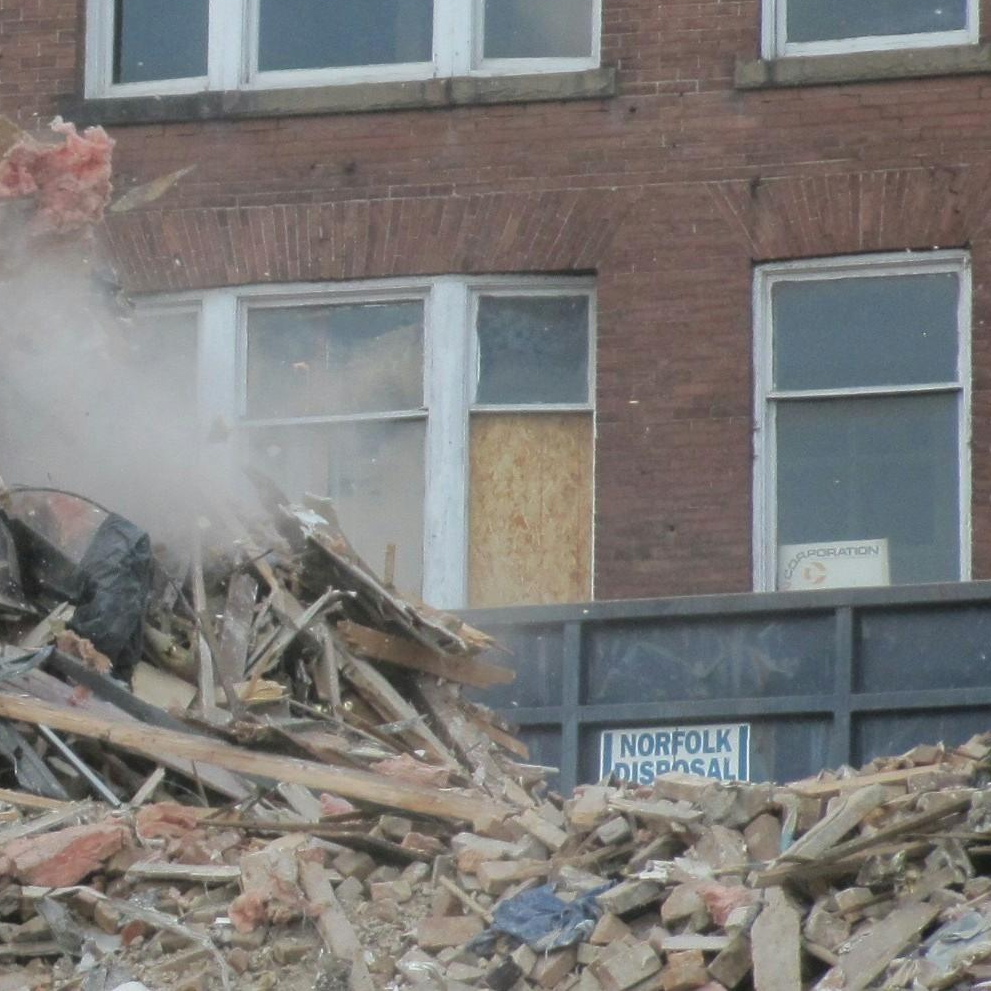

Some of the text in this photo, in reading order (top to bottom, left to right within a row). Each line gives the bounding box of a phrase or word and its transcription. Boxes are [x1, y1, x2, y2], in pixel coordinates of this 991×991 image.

[784, 546, 879, 580] CORPORATION
[620, 729, 732, 758] NORFOLK
[614, 758, 736, 785] DISPOSAL
